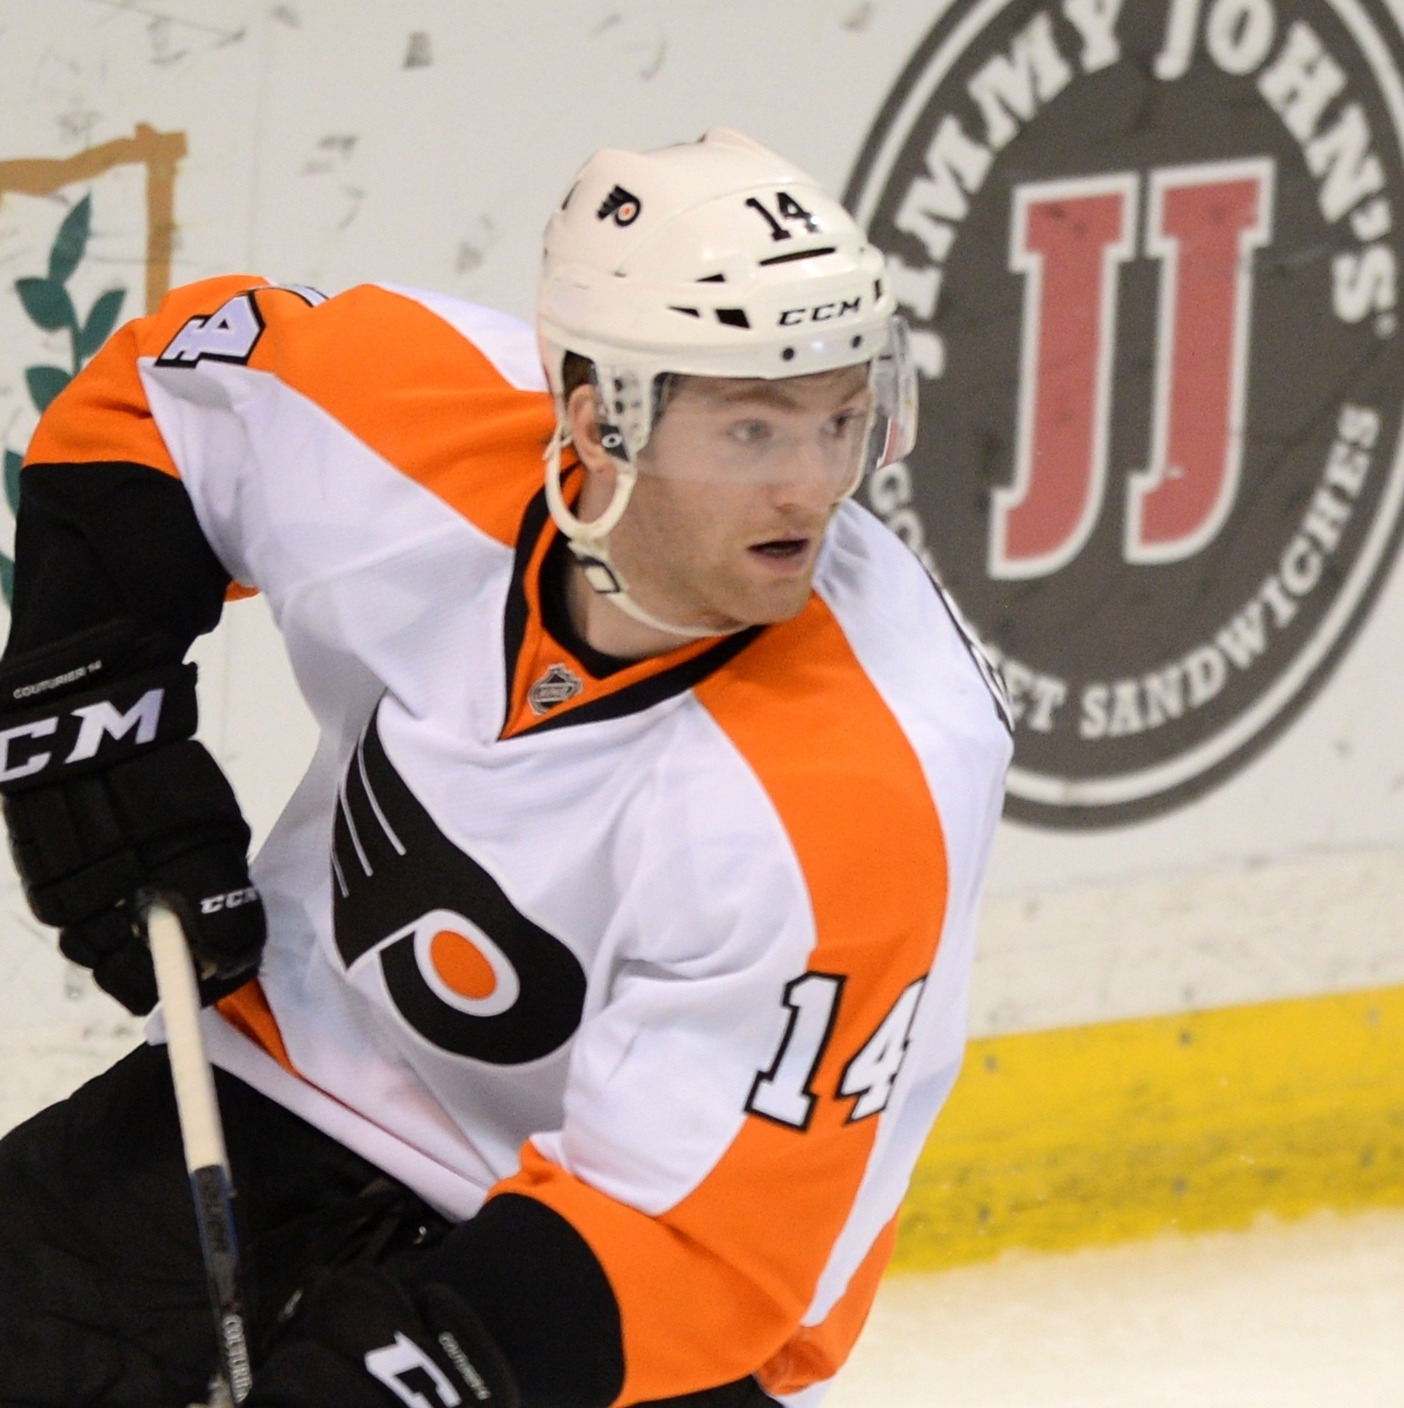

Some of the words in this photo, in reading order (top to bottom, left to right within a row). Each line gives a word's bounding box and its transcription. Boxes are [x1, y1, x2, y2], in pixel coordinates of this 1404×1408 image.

[745, 191, 820, 241] 14
[778, 297, 861, 326] CCM
[988, 154, 1275, 583] JJ
[1079, 405, 1381, 739] SANDWICHES
[744, 970, 929, 1134] 14
